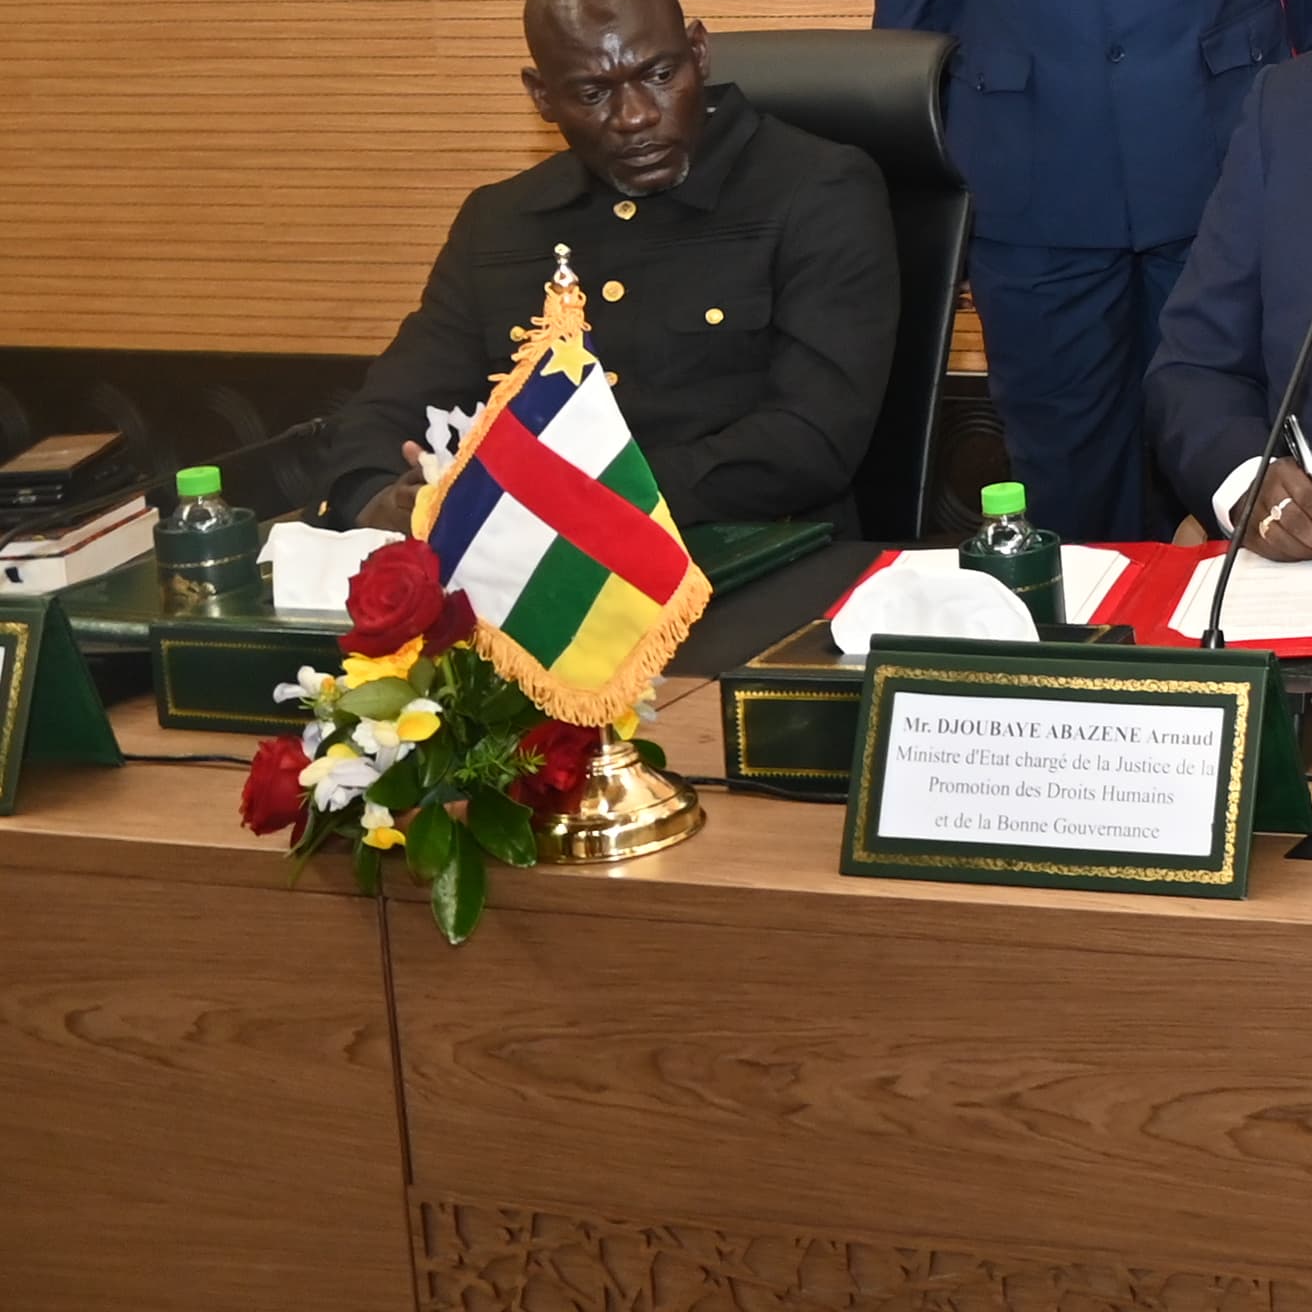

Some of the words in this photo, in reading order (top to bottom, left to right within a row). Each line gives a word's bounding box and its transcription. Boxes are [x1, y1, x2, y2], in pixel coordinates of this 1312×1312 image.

[903, 716, 932, 734] Mr.
[937, 717, 1041, 739] DJOUBAYE
[1045, 723, 1141, 744] ABAZENE
[1146, 729, 1214, 746] Arnaud
[897, 745, 961, 765] Ministre
[1015, 751, 1068, 774] chargé
[1071, 753, 1091, 771] de
[1096, 754, 1110, 772] la
[1115, 755, 1171, 775] Justice
[1175, 759, 1195, 776] de
[1201, 759, 1214, 776] la
[928, 776, 1010, 796] Promotion
[1015, 780, 1041, 798] des
[1047, 782, 1096, 801] Droits
[1102, 784, 1174, 804] Humains
[934, 813, 948, 828] et
[953, 812, 973, 829] de
[978, 813, 991, 830] la
[997, 814, 1049, 833] Bonne
[1053, 818, 1160, 839] Gouvernance
